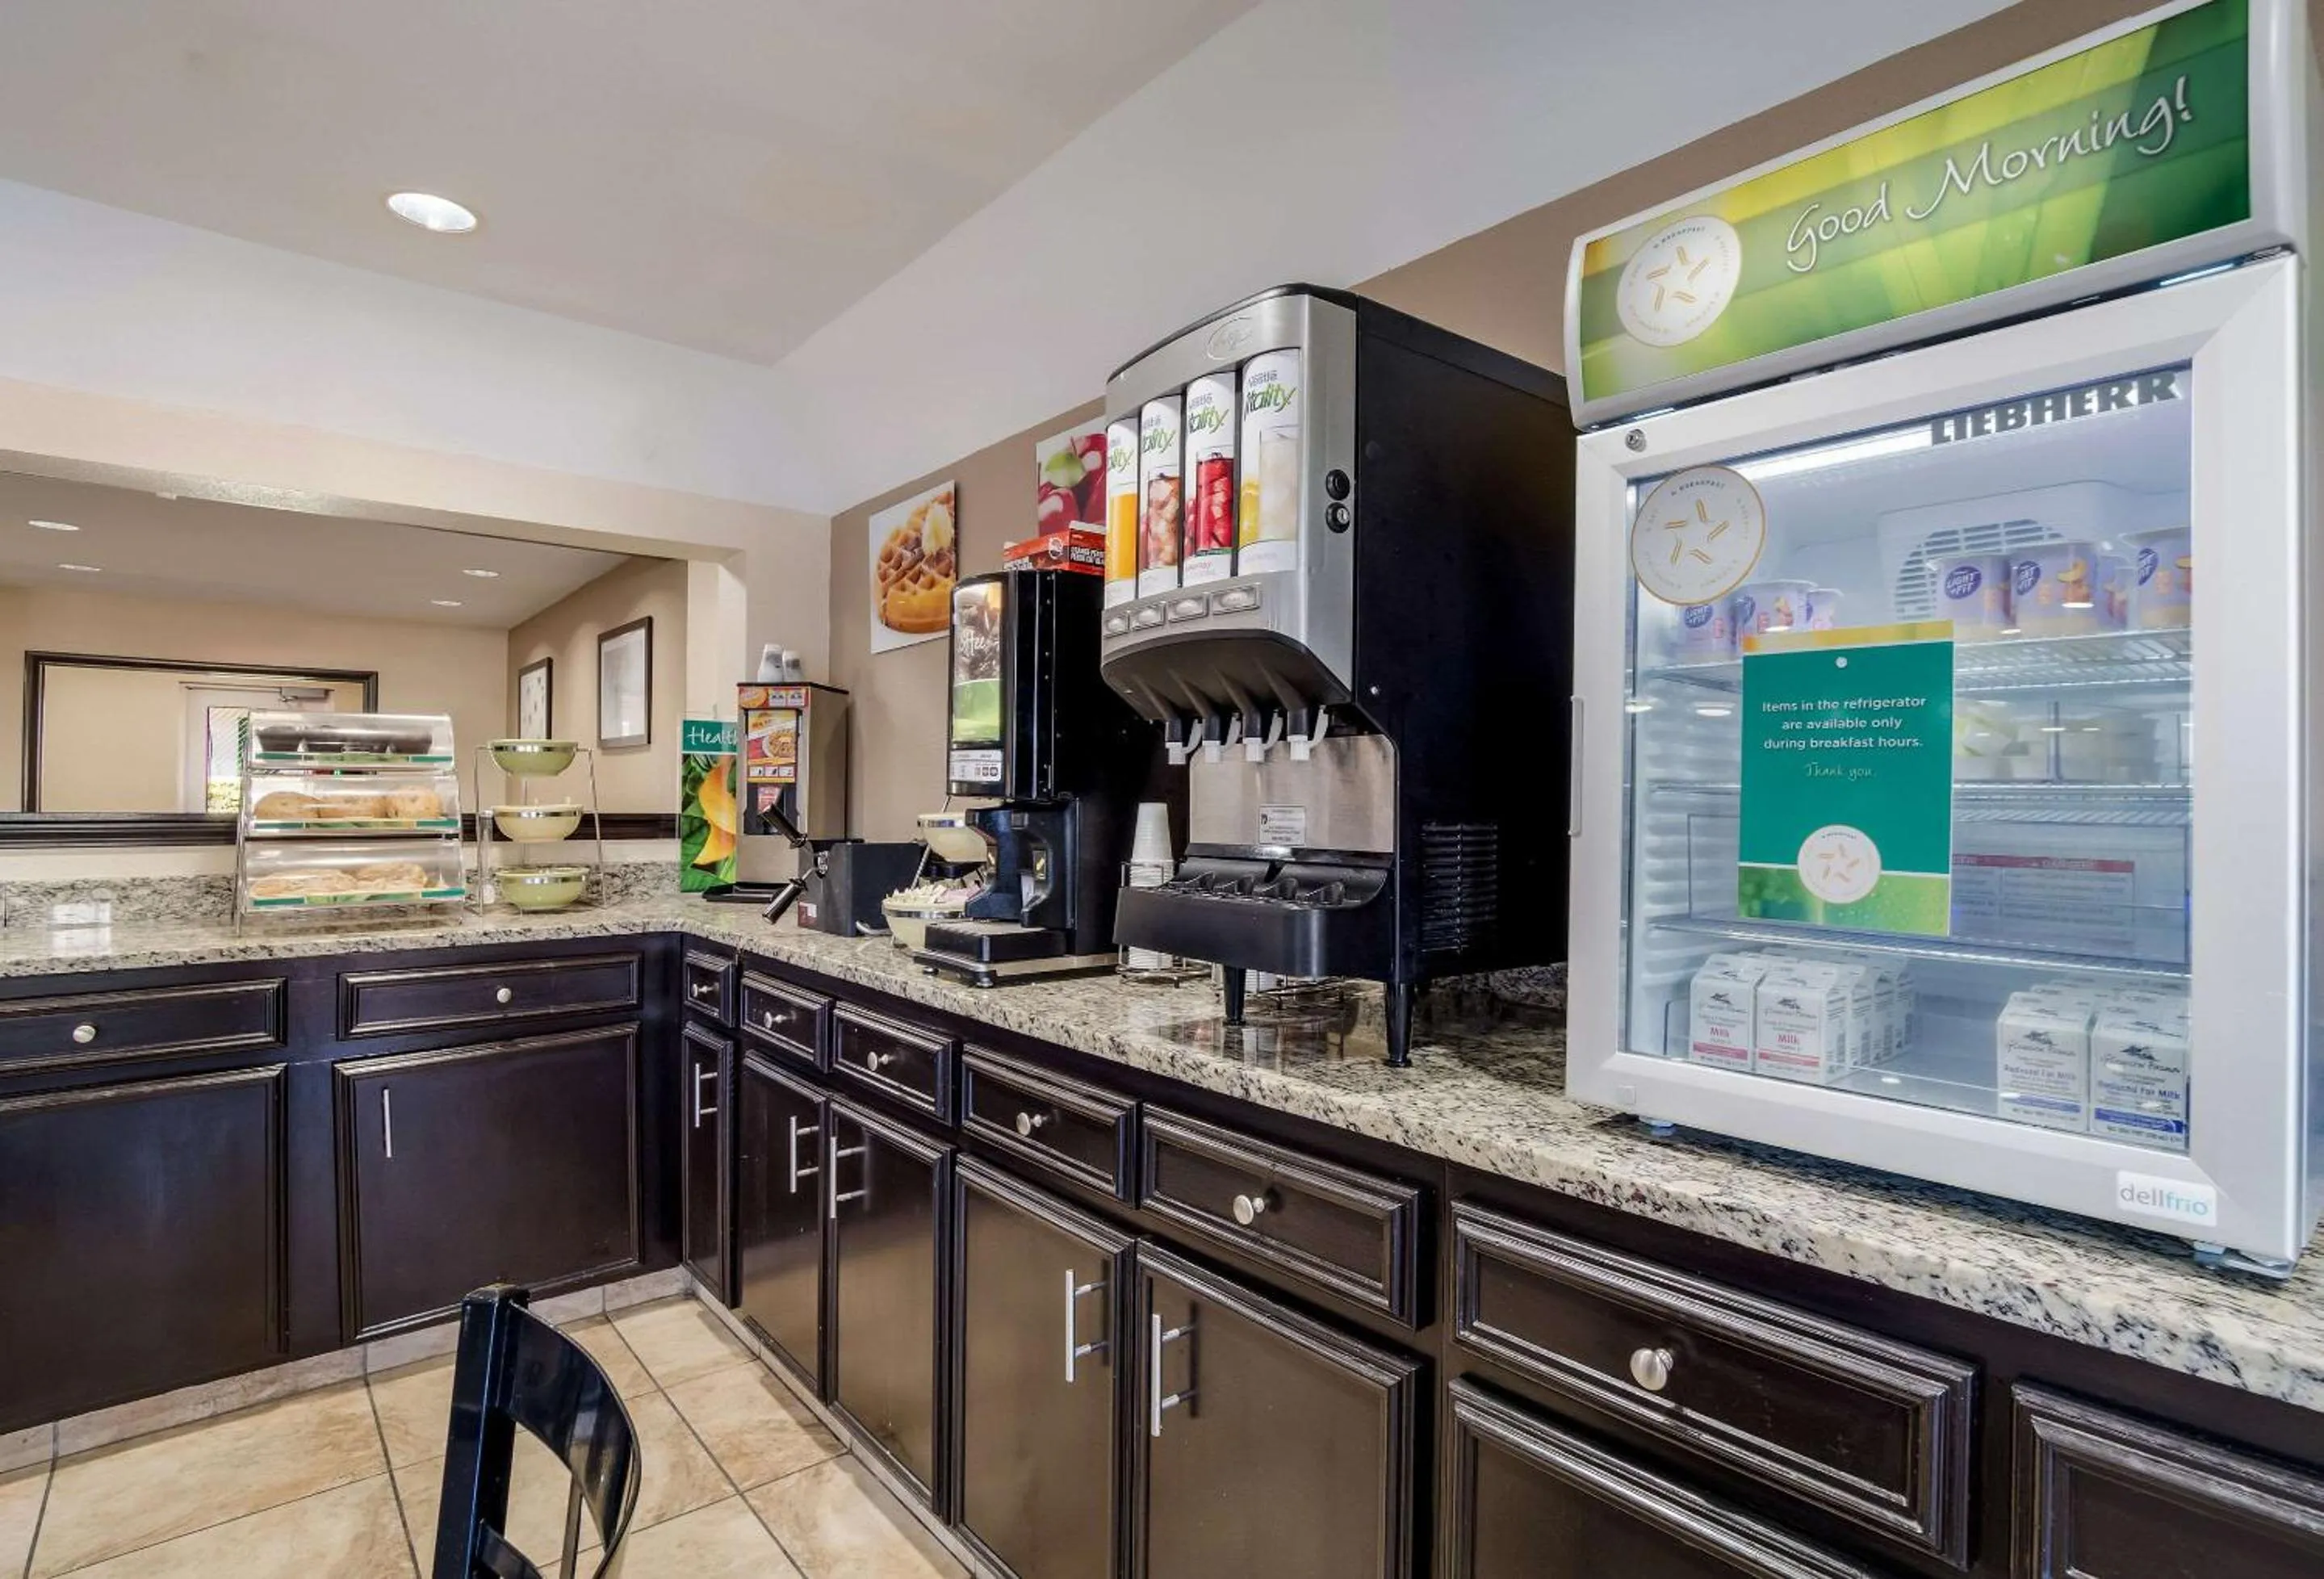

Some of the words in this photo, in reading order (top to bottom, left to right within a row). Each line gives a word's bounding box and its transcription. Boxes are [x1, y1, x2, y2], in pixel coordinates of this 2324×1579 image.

[1786, 182, 1892, 272] Good
[1906, 75, 2192, 220] Morning!
[1932, 372, 2178, 445] LIEBHERR
[1762, 701, 1798, 712] Items
[1801, 700, 1814, 711] in
[1817, 700, 1840, 710] the
[1844, 697, 1926, 710] refrigerator
[1782, 720, 1803, 731] are
[1807, 717, 1867, 729] available
[1871, 717, 1903, 730] only
[1764, 738, 1806, 751] during
[1810, 737, 1874, 748] breakfast
[1878, 736, 1924, 748] hours.
[1805, 761, 1844, 777] Thank
[1778, 1033, 1800, 1045] Milk
[2159, 1090, 2180, 1099] Milk
[2120, 1183, 2209, 1216] dellfrio
